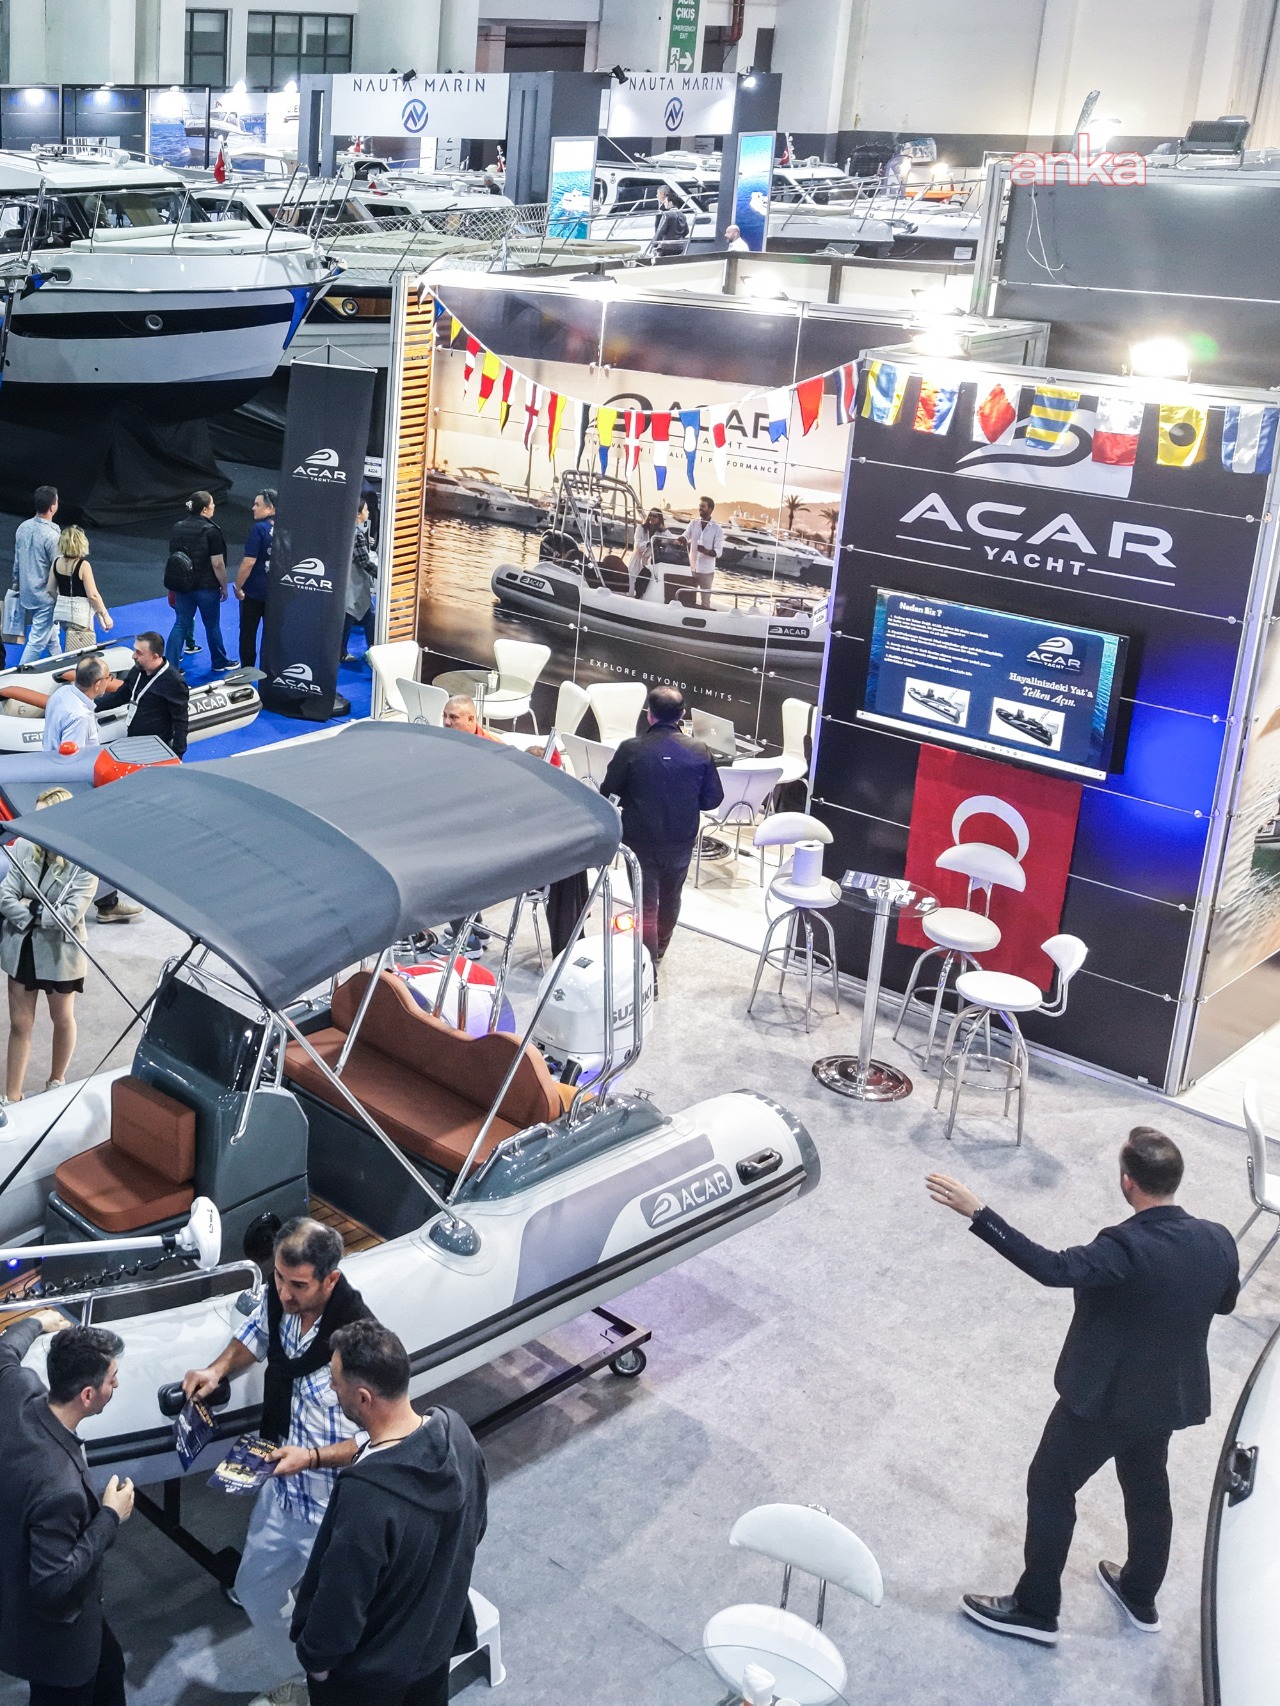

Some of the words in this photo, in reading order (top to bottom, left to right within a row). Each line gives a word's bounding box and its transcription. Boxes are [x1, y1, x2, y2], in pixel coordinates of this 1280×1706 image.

[676, 7, 696, 21] ÇIKIŞ
[353, 78, 413, 92] NAUTA
[424, 78, 486, 92] MARIN
[629, 77, 674, 91] NAUTA
[682, 77, 724, 91] MARIN
[293, 465, 347, 481] ACAR
[708, 457, 779, 474] PFORMANCE
[899, 492, 1177, 568] ACAR
[984, 545, 1086, 575] YACHT
[280, 574, 333, 590] ACAR
[528, 579, 544, 588] ACAR
[900, 601, 924, 614] Neden
[924, 607, 936, 616] Biz
[783, 628, 807, 636] ACAR
[1026, 650, 1081, 669] ACAR
[272, 677, 322, 693] ACAR
[590, 659, 637, 676] EXPLORE
[643, 673, 687, 690] BEYOND
[693, 686, 732, 702] LIMITS
[1009, 672, 1068, 692] Hayalinizdeki
[1070, 686, 1094, 698] Yat'a
[289, 685, 308, 693] YACHT
[196, 695, 227, 713] ACAR
[681, 1171, 730, 1211] ACAR
